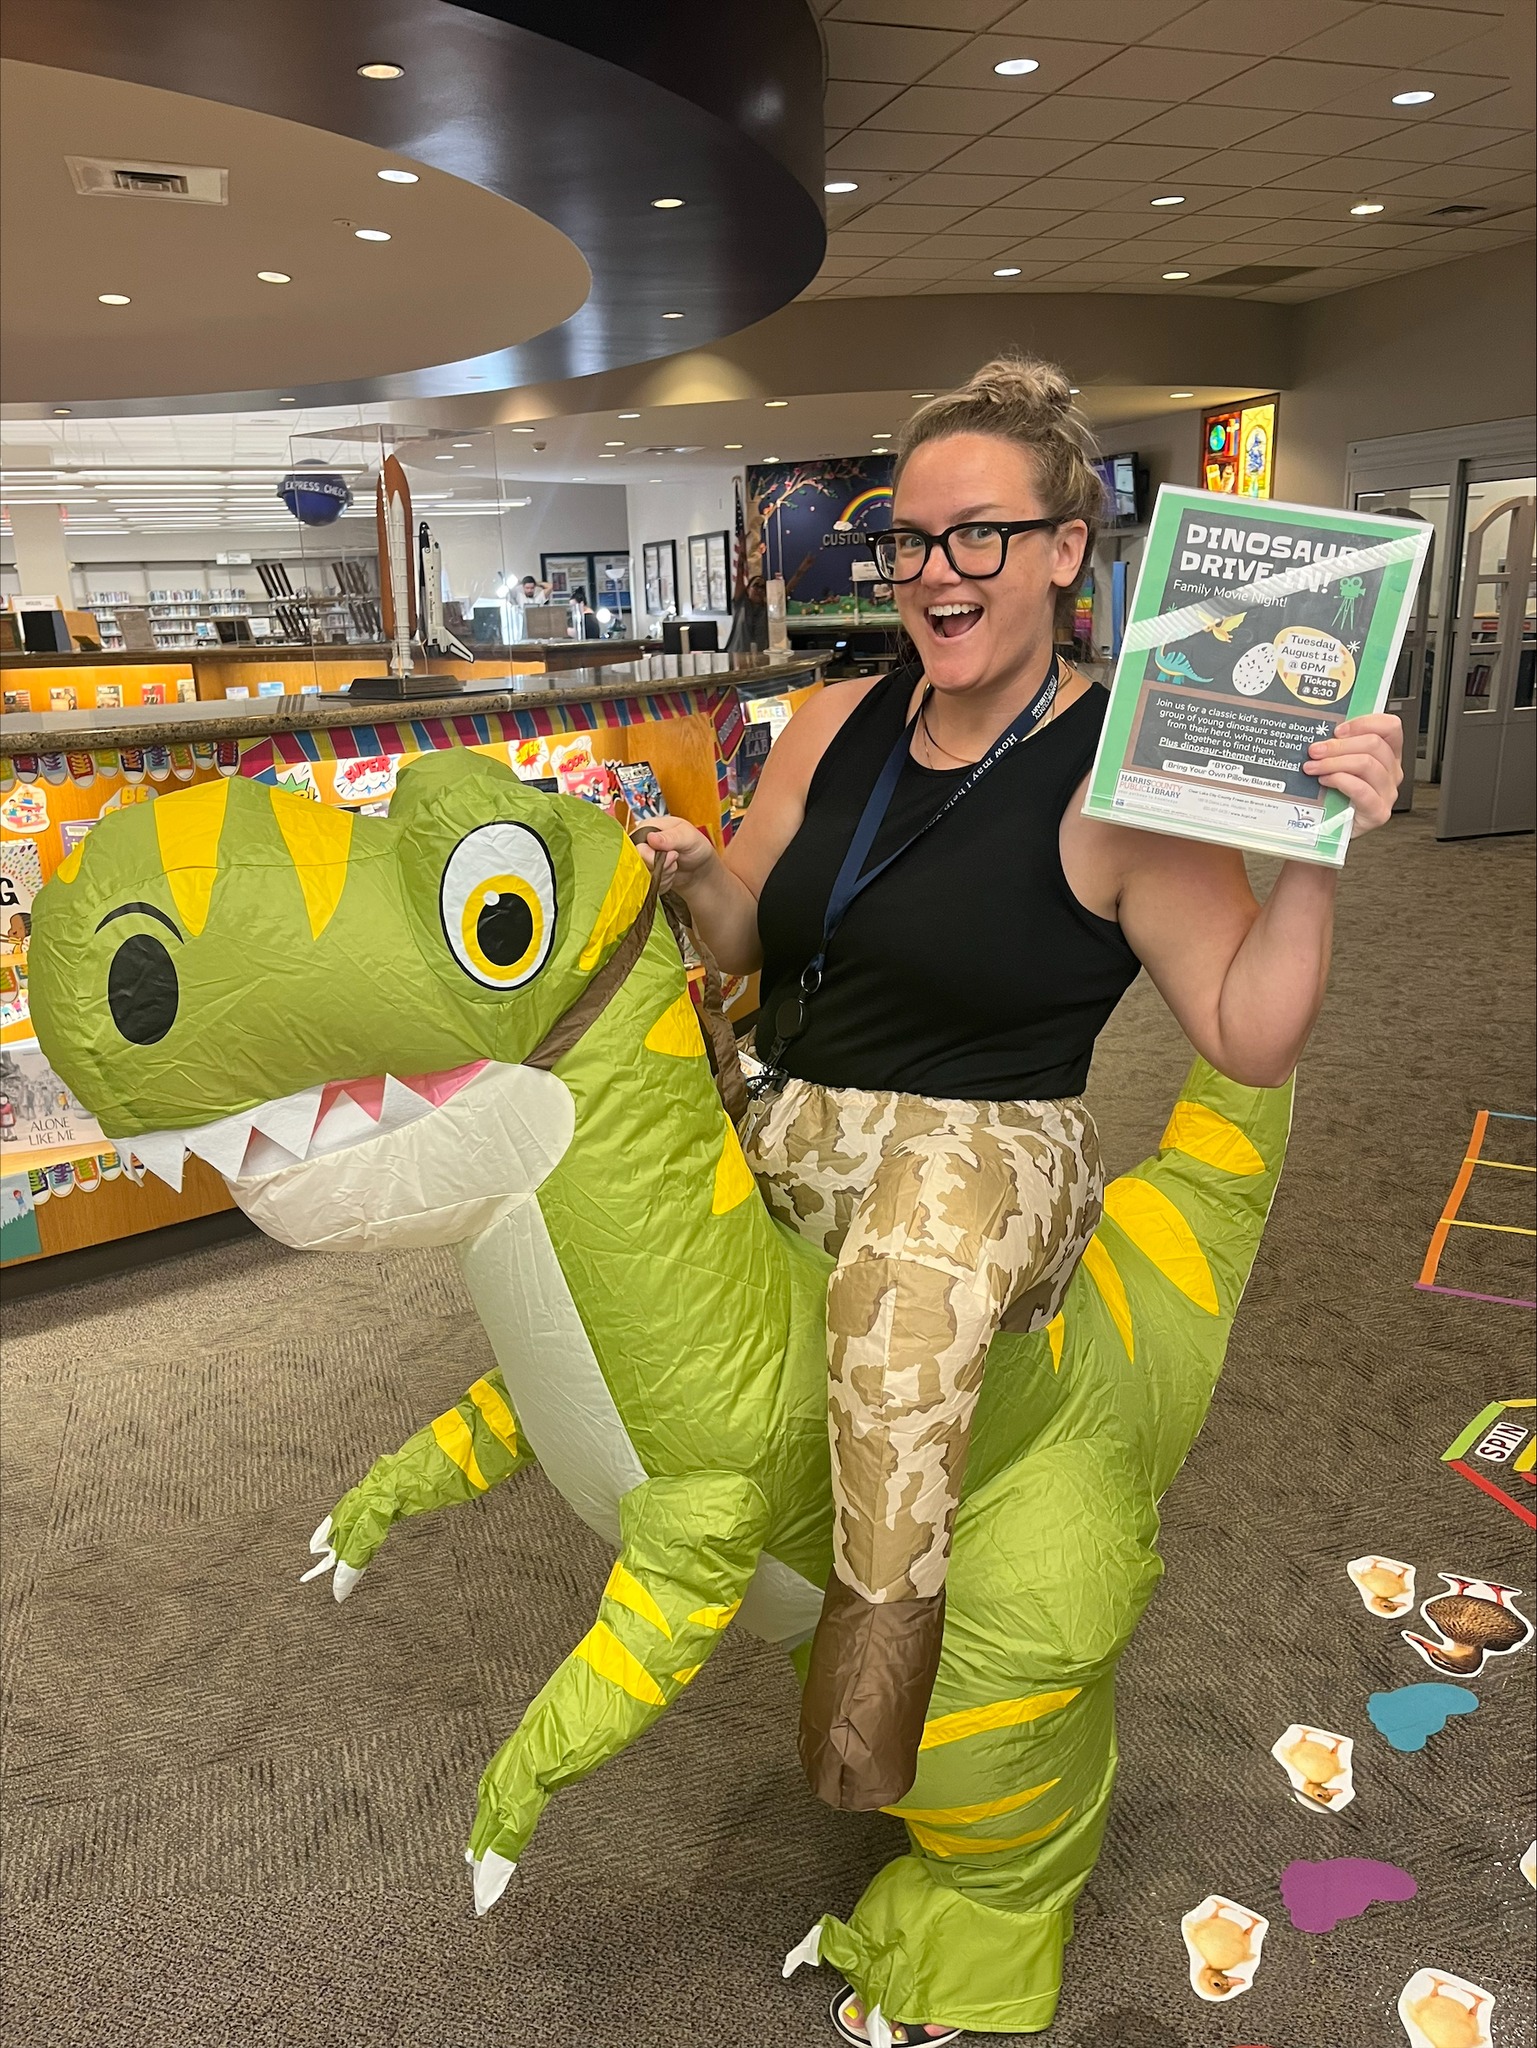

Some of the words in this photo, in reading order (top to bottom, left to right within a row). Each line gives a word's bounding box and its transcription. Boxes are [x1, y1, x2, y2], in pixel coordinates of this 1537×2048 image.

[285, 481, 320, 492] EXPRESS
[1172, 579, 1212, 598] Family
[1213, 586, 1249, 602] Movie
[1251, 592, 1288, 608] Night!
[1281, 646, 1320, 660] August
[1321, 652, 1340, 662] 1st
[1292, 634, 1336, 652] Tuesday
[1300, 662, 1326, 673] 6PM
[1303, 676, 1337, 688] Tickets
[1312, 687, 1334, 697] 5:30
[1156, 698, 1173, 708] Join
[1175, 702, 1185, 710] us
[1187, 703, 1200, 712] for
[1208, 708, 1236, 720] classic
[1238, 713, 1258, 724] kid's
[1260, 718, 1286, 729] movie
[1288, 722, 1314, 734] about
[1160, 710, 1185, 722] group
[1187, 712, 1198, 722] of
[1198, 716, 1224, 728] young
[1226, 721, 1268, 736] dinosaurs
[1270, 728, 1314, 744] separated
[994, 732, 1018, 758] How
[1167, 719, 1188, 730] from
[1189, 722, 1208, 734] their
[1210, 726, 1232, 739] herd,
[1234, 732, 1254, 742] who
[1255, 736, 1278, 746] must
[1279, 739, 1302, 750] band
[1184, 732, 1222, 746] together
[1222, 738, 1232, 747] to
[1233, 740, 1253, 752] find
[1252, 744, 1276, 756] them.
[1160, 736, 1179, 748] Plus
[1180, 739, 1256, 762] dinosaur-themed
[1258, 756, 1300, 770] activities!
[344, 755, 391, 784] SUPER
[972, 757, 994, 781] may
[1189, 766, 1208, 775] Your
[1208, 770, 1226, 778] Own
[121, 786, 149, 805] BE
[944, 788, 966, 811] help
[30, 1116, 70, 1132] ALONE
[28, 1132, 54, 1146] LIKE
[57, 1128, 76, 1141] ME
[1480, 1423, 1526, 1460] SPIN
